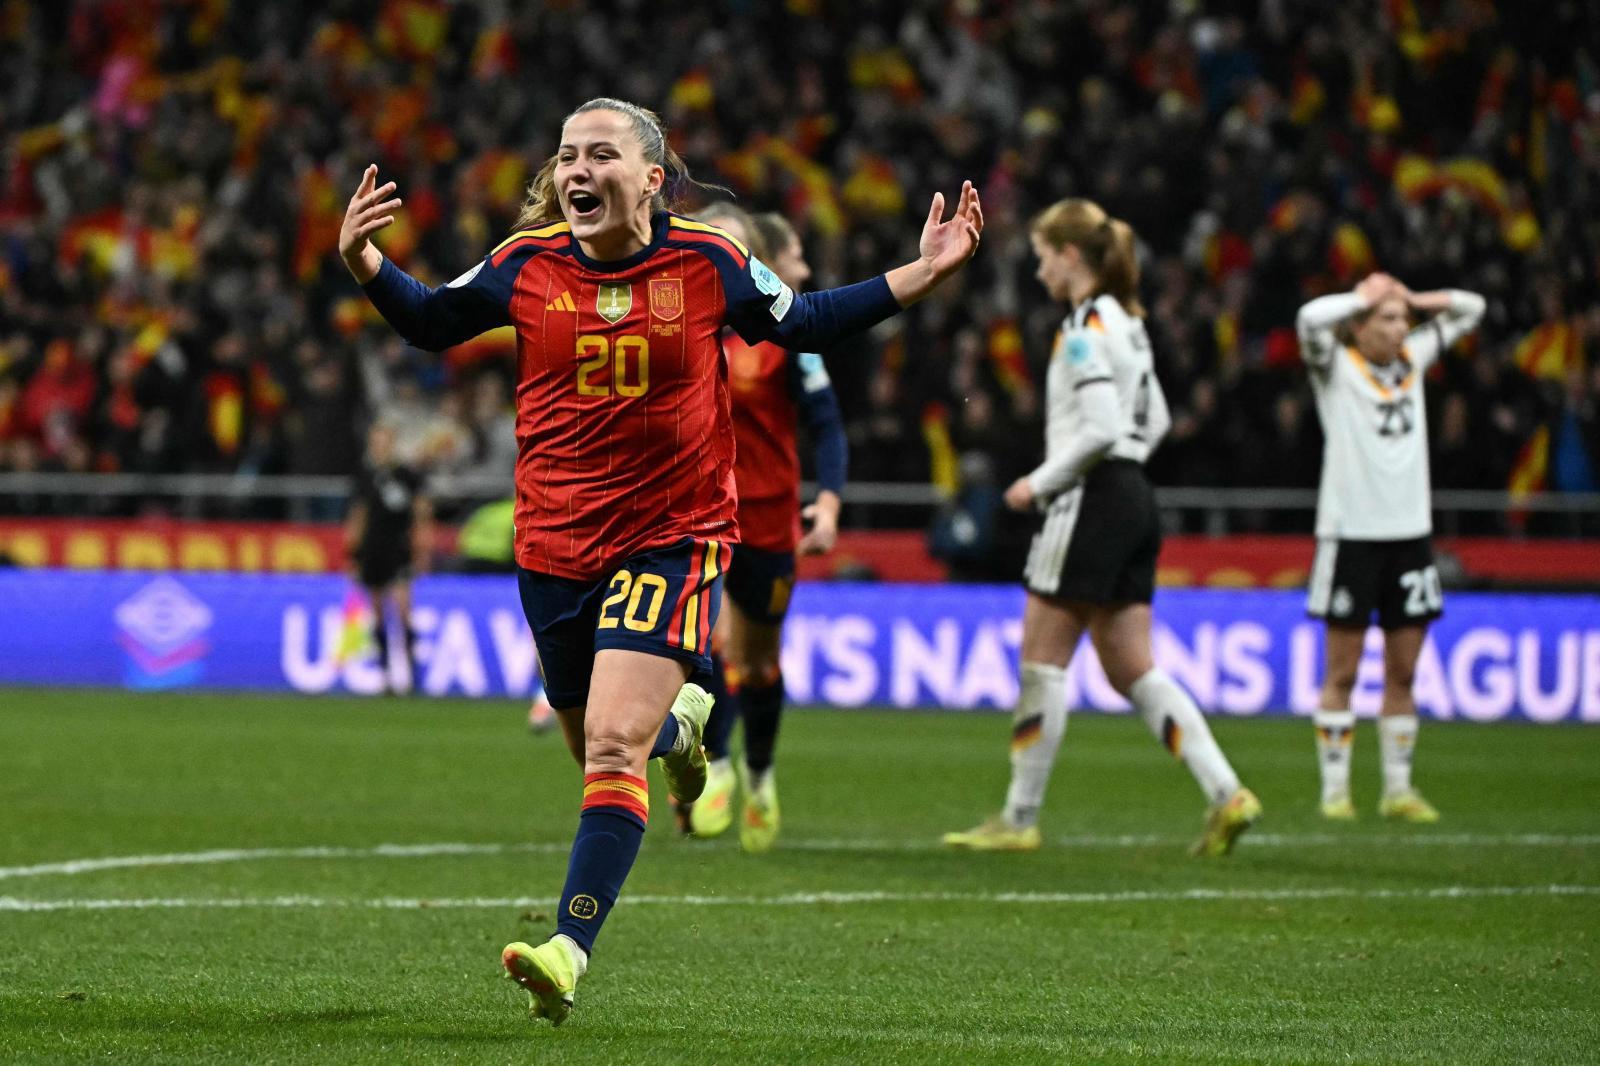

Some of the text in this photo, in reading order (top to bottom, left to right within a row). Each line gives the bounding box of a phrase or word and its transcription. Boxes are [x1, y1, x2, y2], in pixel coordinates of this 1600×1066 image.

[576, 335, 649, 397] 20
[598, 569, 667, 632] 20
[890, 617, 1274, 715] NANS
